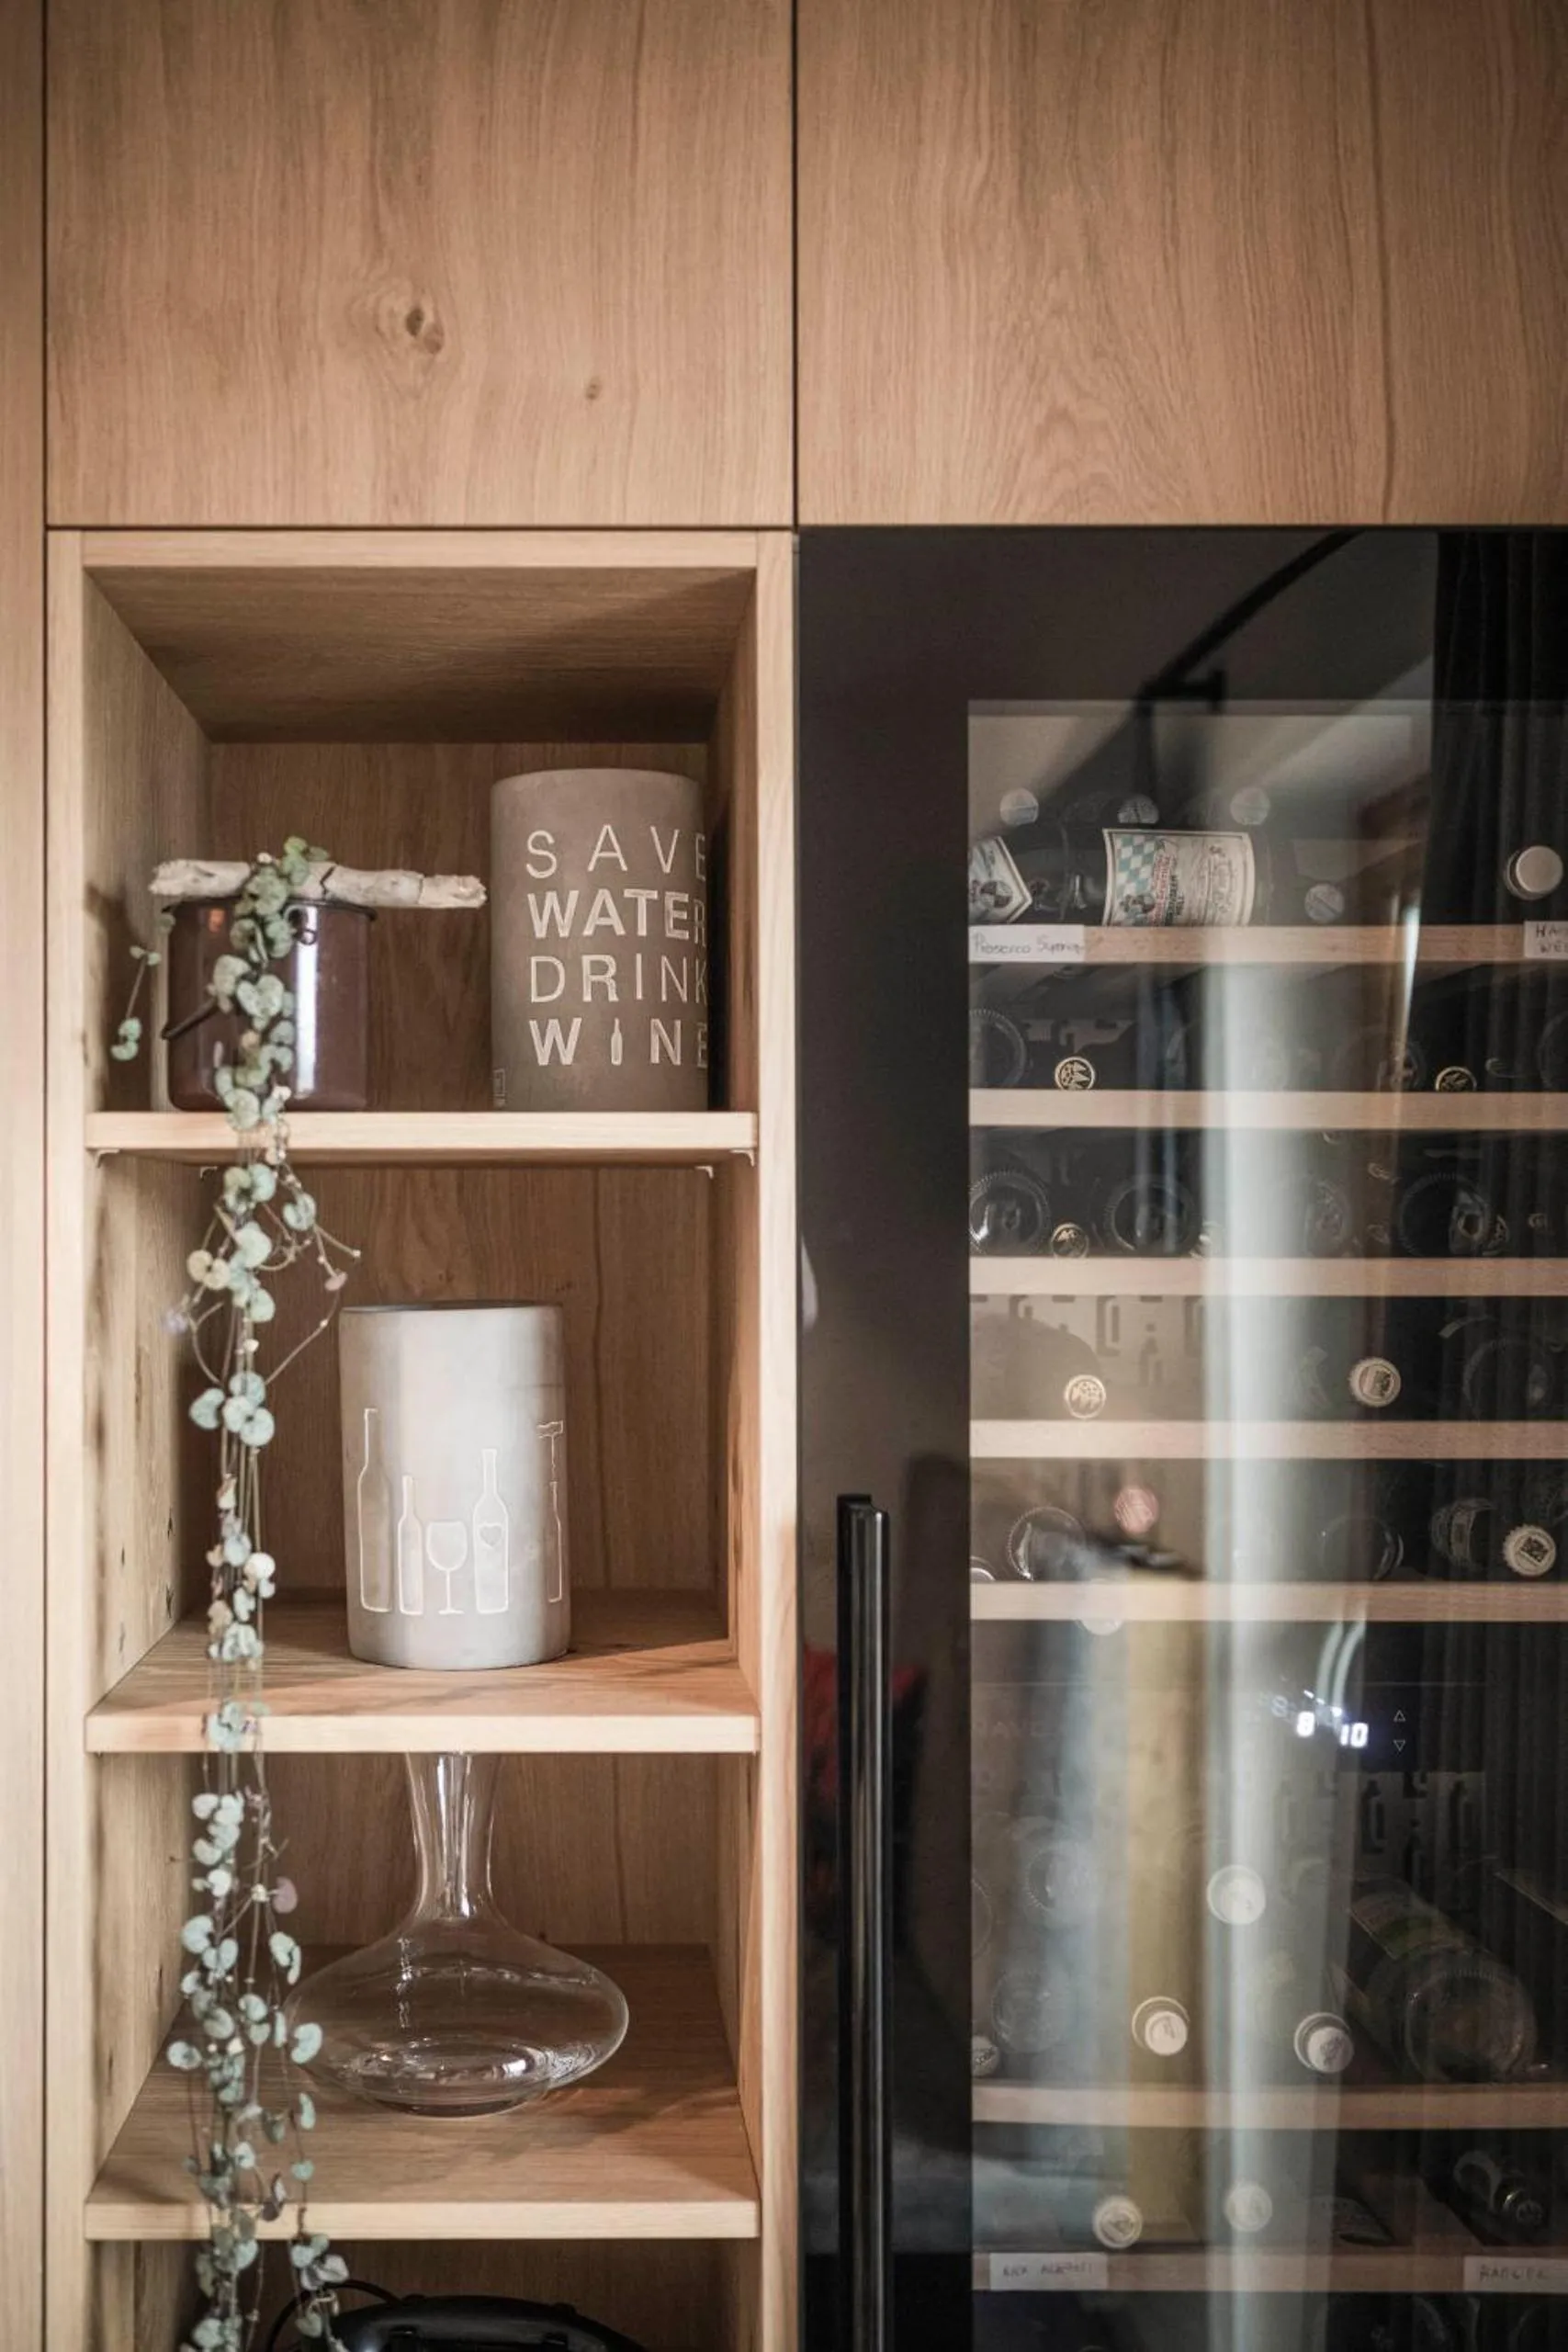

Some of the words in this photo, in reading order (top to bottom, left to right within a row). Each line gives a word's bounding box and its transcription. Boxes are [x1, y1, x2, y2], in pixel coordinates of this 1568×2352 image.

[525, 824, 706, 882] SAVE
[527, 888, 706, 947] WATER
[530, 953, 707, 1005] DRINK
[1339, 1722, 1369, 1747] 10
